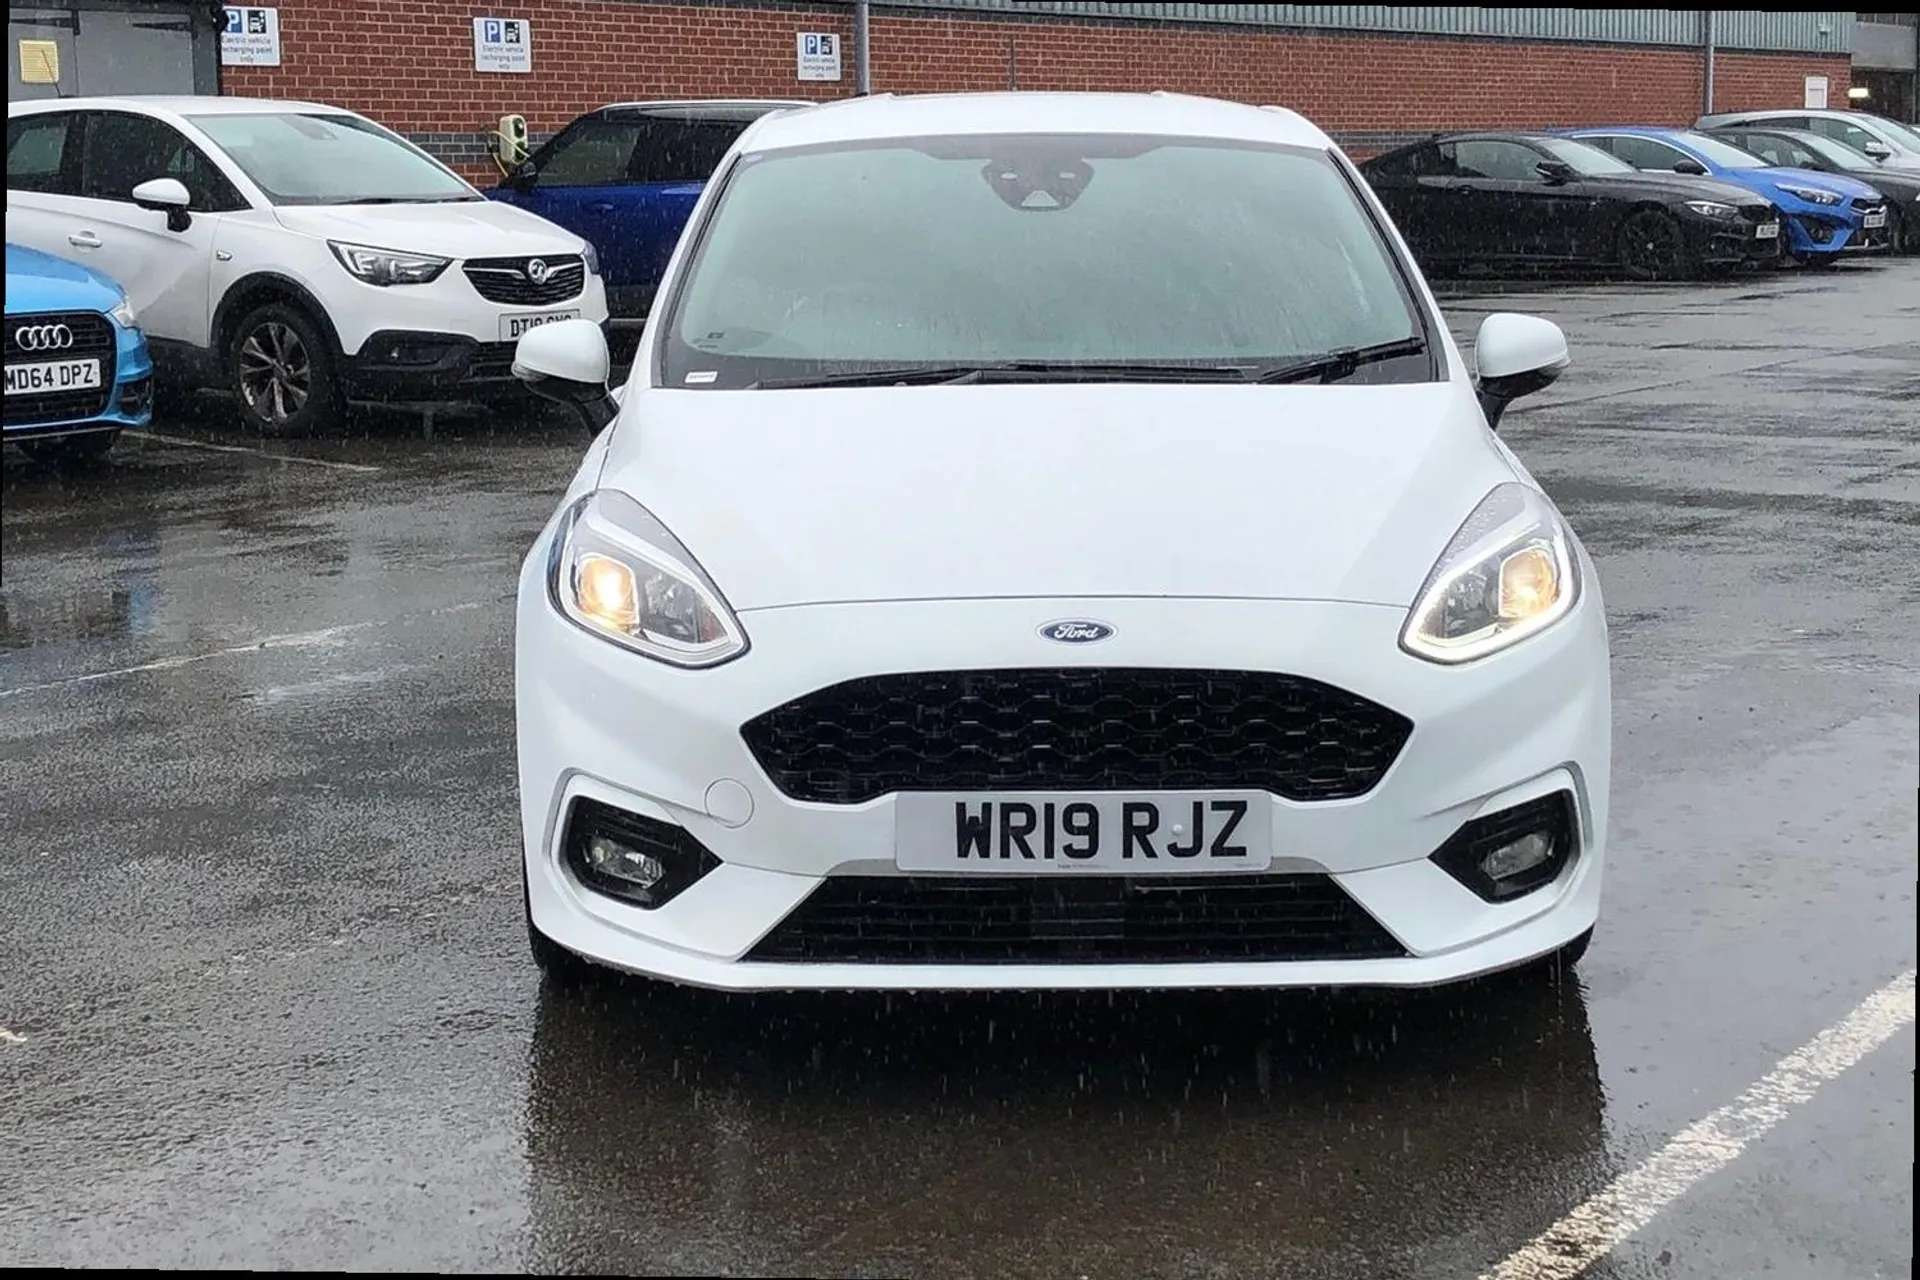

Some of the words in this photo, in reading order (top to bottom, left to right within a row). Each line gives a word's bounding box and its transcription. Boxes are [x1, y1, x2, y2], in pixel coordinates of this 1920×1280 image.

[225, 11, 240, 31] P
[487, 22, 498, 41] P
[807, 36, 817, 53] P
[4, 366, 54, 391] MD64
[60, 363, 93, 386] DPZ
[1053, 623, 1099, 639] Ford
[955, 801, 1101, 859] WR19
[1121, 800, 1248, 858] RJZ
